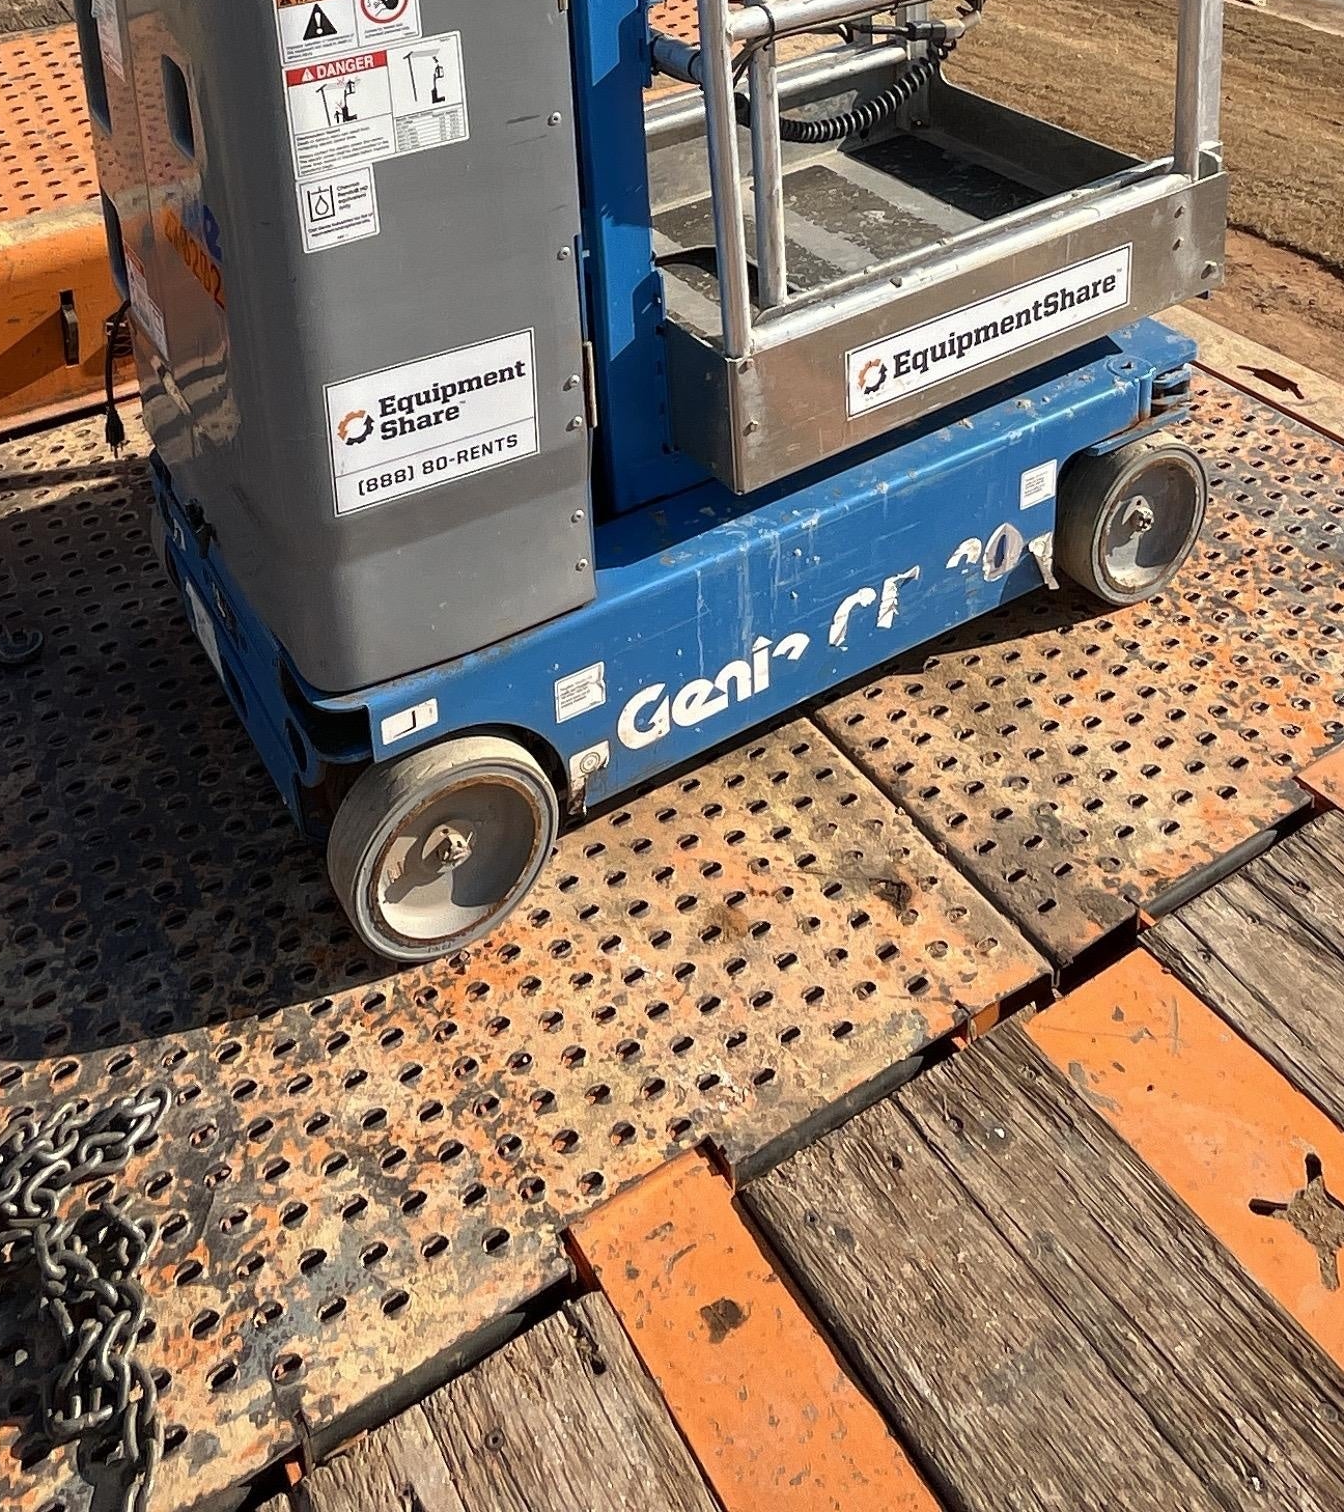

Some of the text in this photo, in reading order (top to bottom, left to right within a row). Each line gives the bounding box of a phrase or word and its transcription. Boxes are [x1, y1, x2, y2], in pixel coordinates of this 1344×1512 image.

[316, 54, 375, 79] DANGER
[892, 272, 1116, 379] EquipmentShare
[378, 360, 526, 418] Equipment
[380, 404, 460, 441] Share
[358, 434, 519, 496] (888) 80-RENTS
